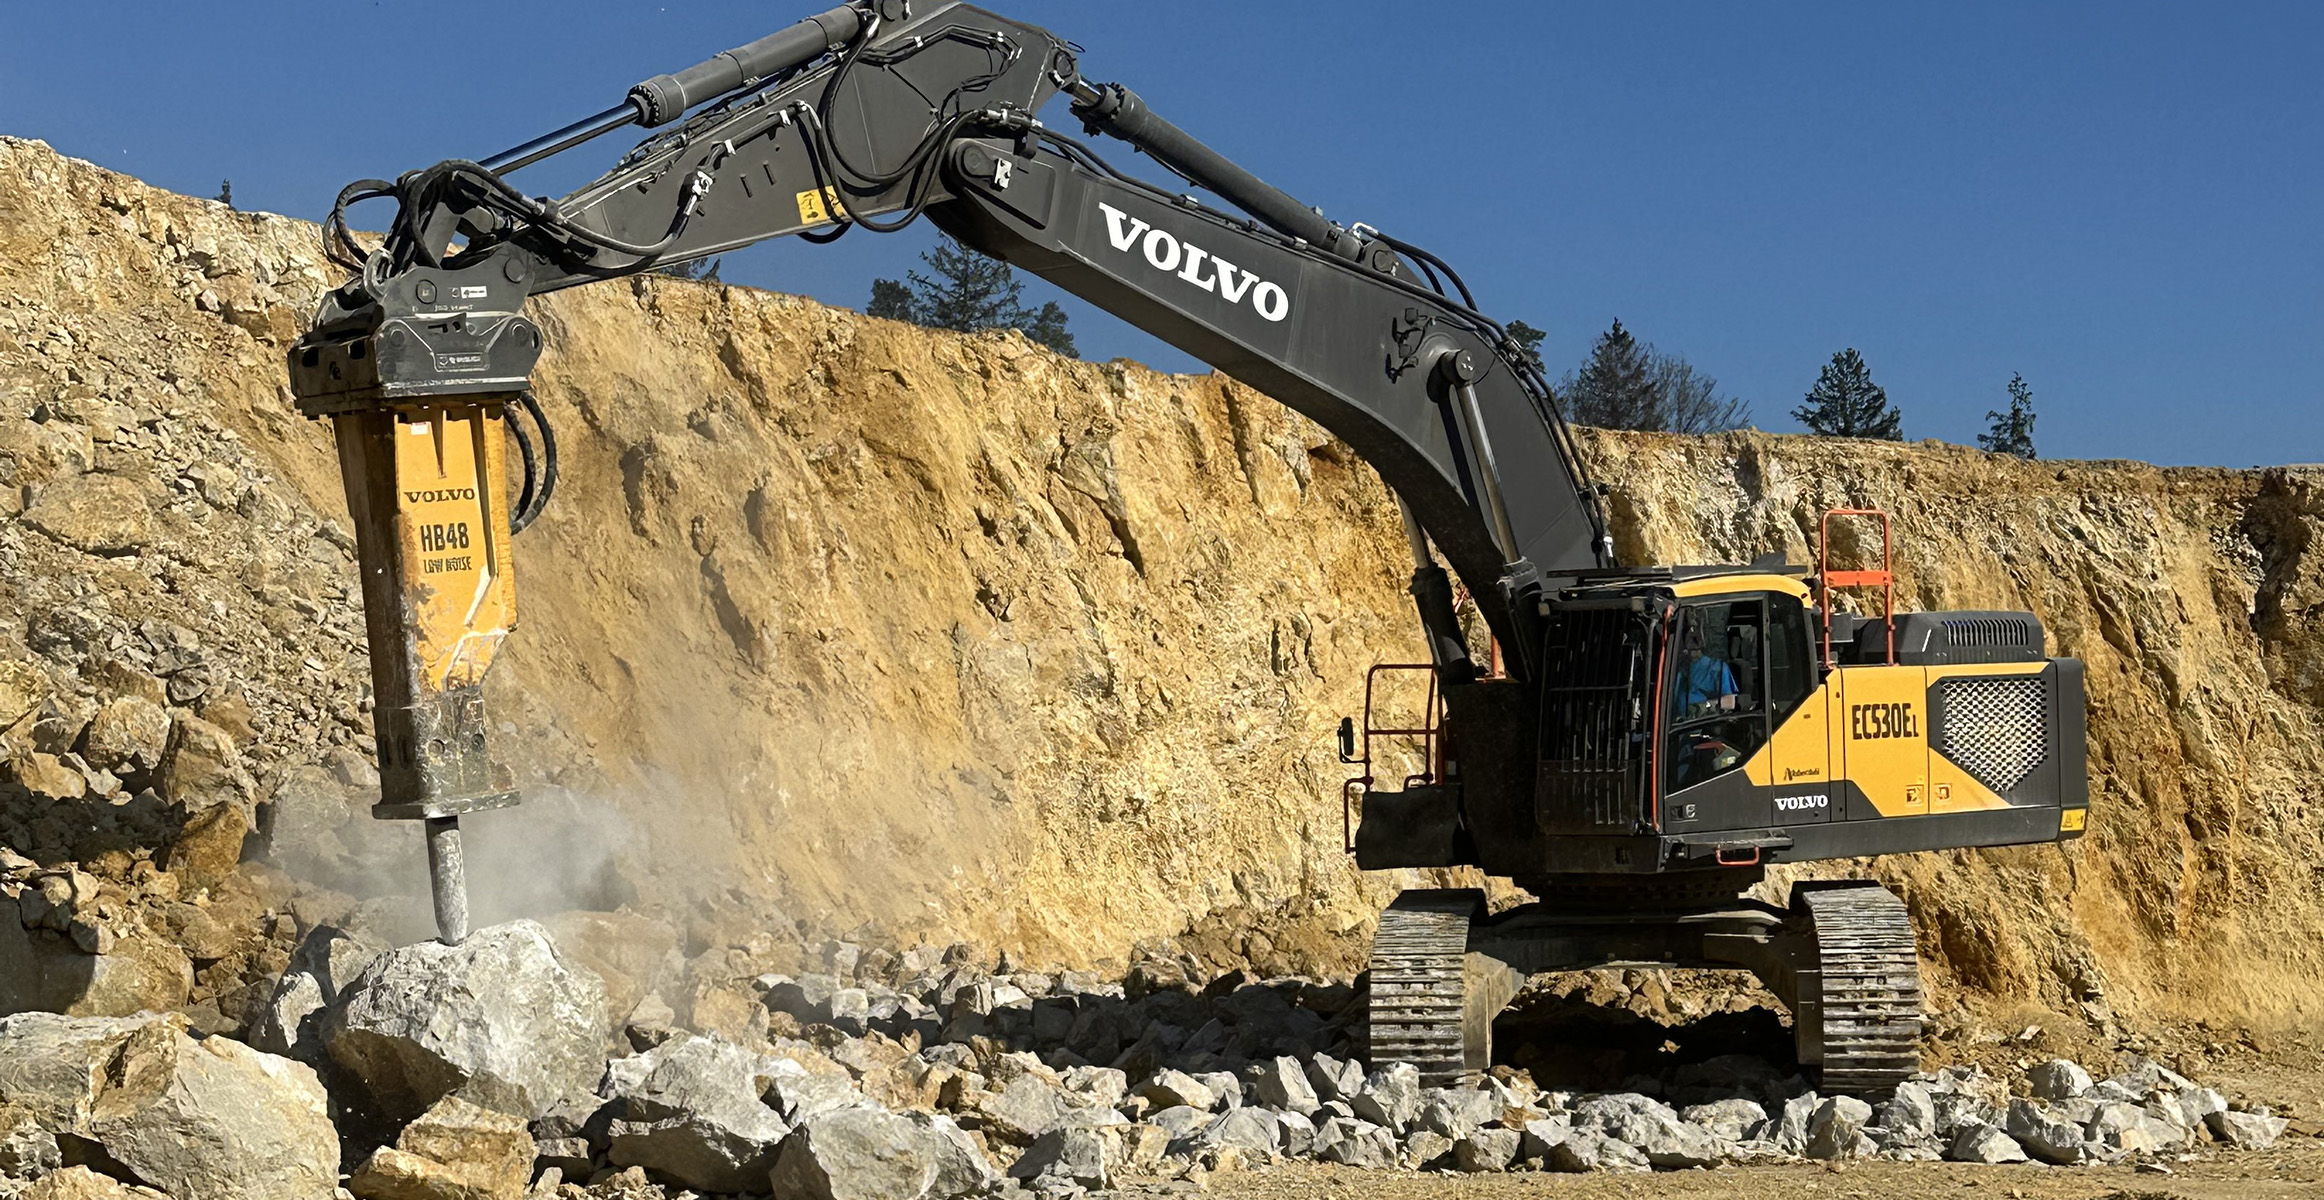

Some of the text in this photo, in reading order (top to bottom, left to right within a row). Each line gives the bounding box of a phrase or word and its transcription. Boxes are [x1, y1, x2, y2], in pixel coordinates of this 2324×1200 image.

[1098, 201, 1289, 322] VOLVO
[403, 487, 476, 504] VOLVO
[419, 522, 470, 552] HB48
[423, 555, 473, 574] LOW NOISE
[1774, 794, 1829, 811] VOLVO
